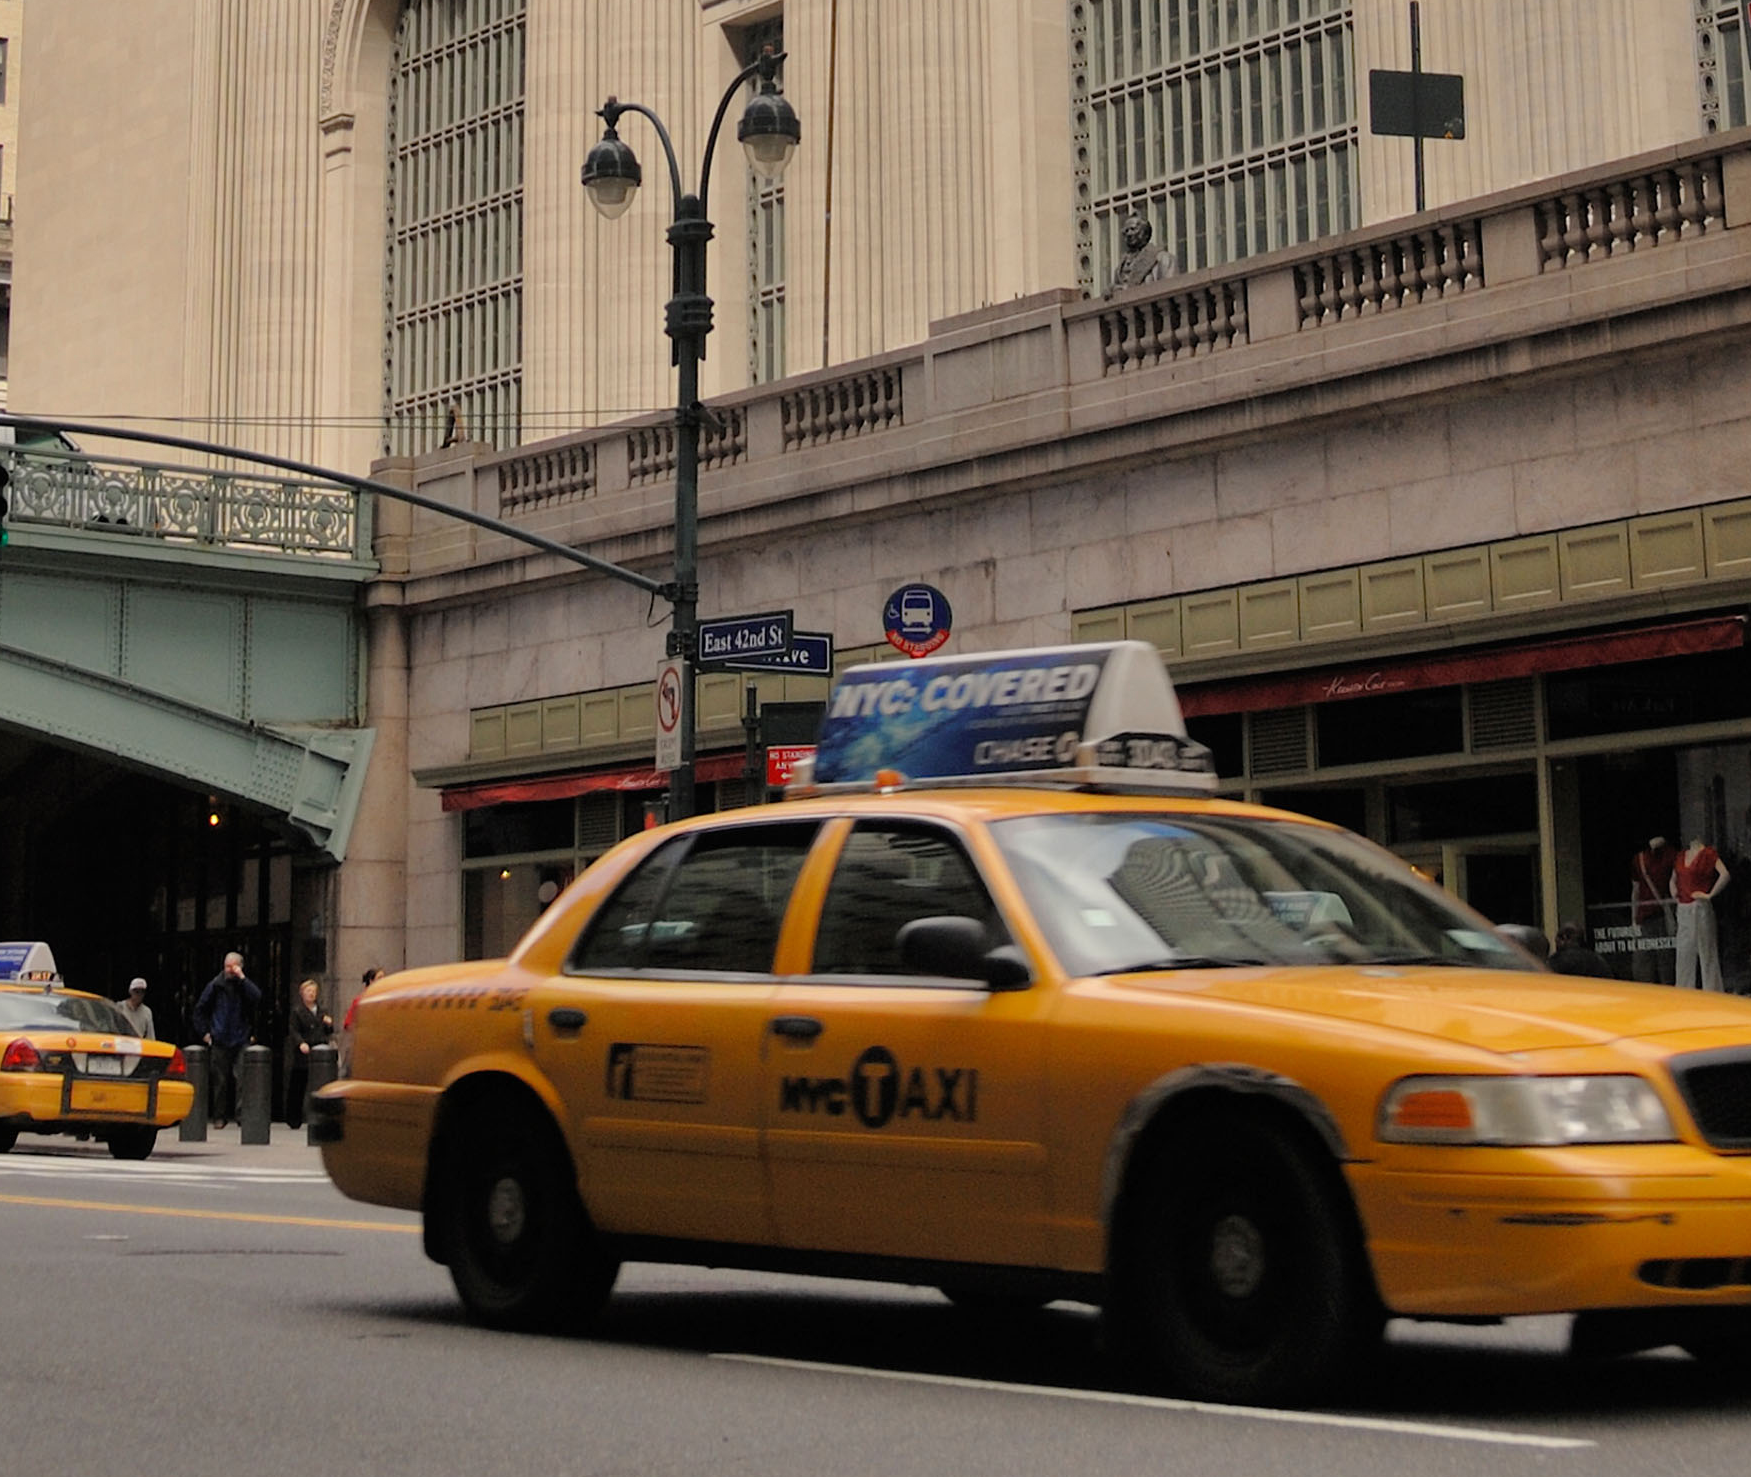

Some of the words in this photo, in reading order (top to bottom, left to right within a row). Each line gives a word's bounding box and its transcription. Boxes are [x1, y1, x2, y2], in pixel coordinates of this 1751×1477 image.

[704, 633, 732, 654] East
[734, 627, 766, 651] 42nd
[768, 626, 784, 646] St
[890, 633, 902, 647] NO
[831, 679, 920, 720] NYC:
[920, 663, 1100, 714] COVERED
[780, 1076, 847, 1117] NYC
[856, 1058, 980, 1123] TAXI
